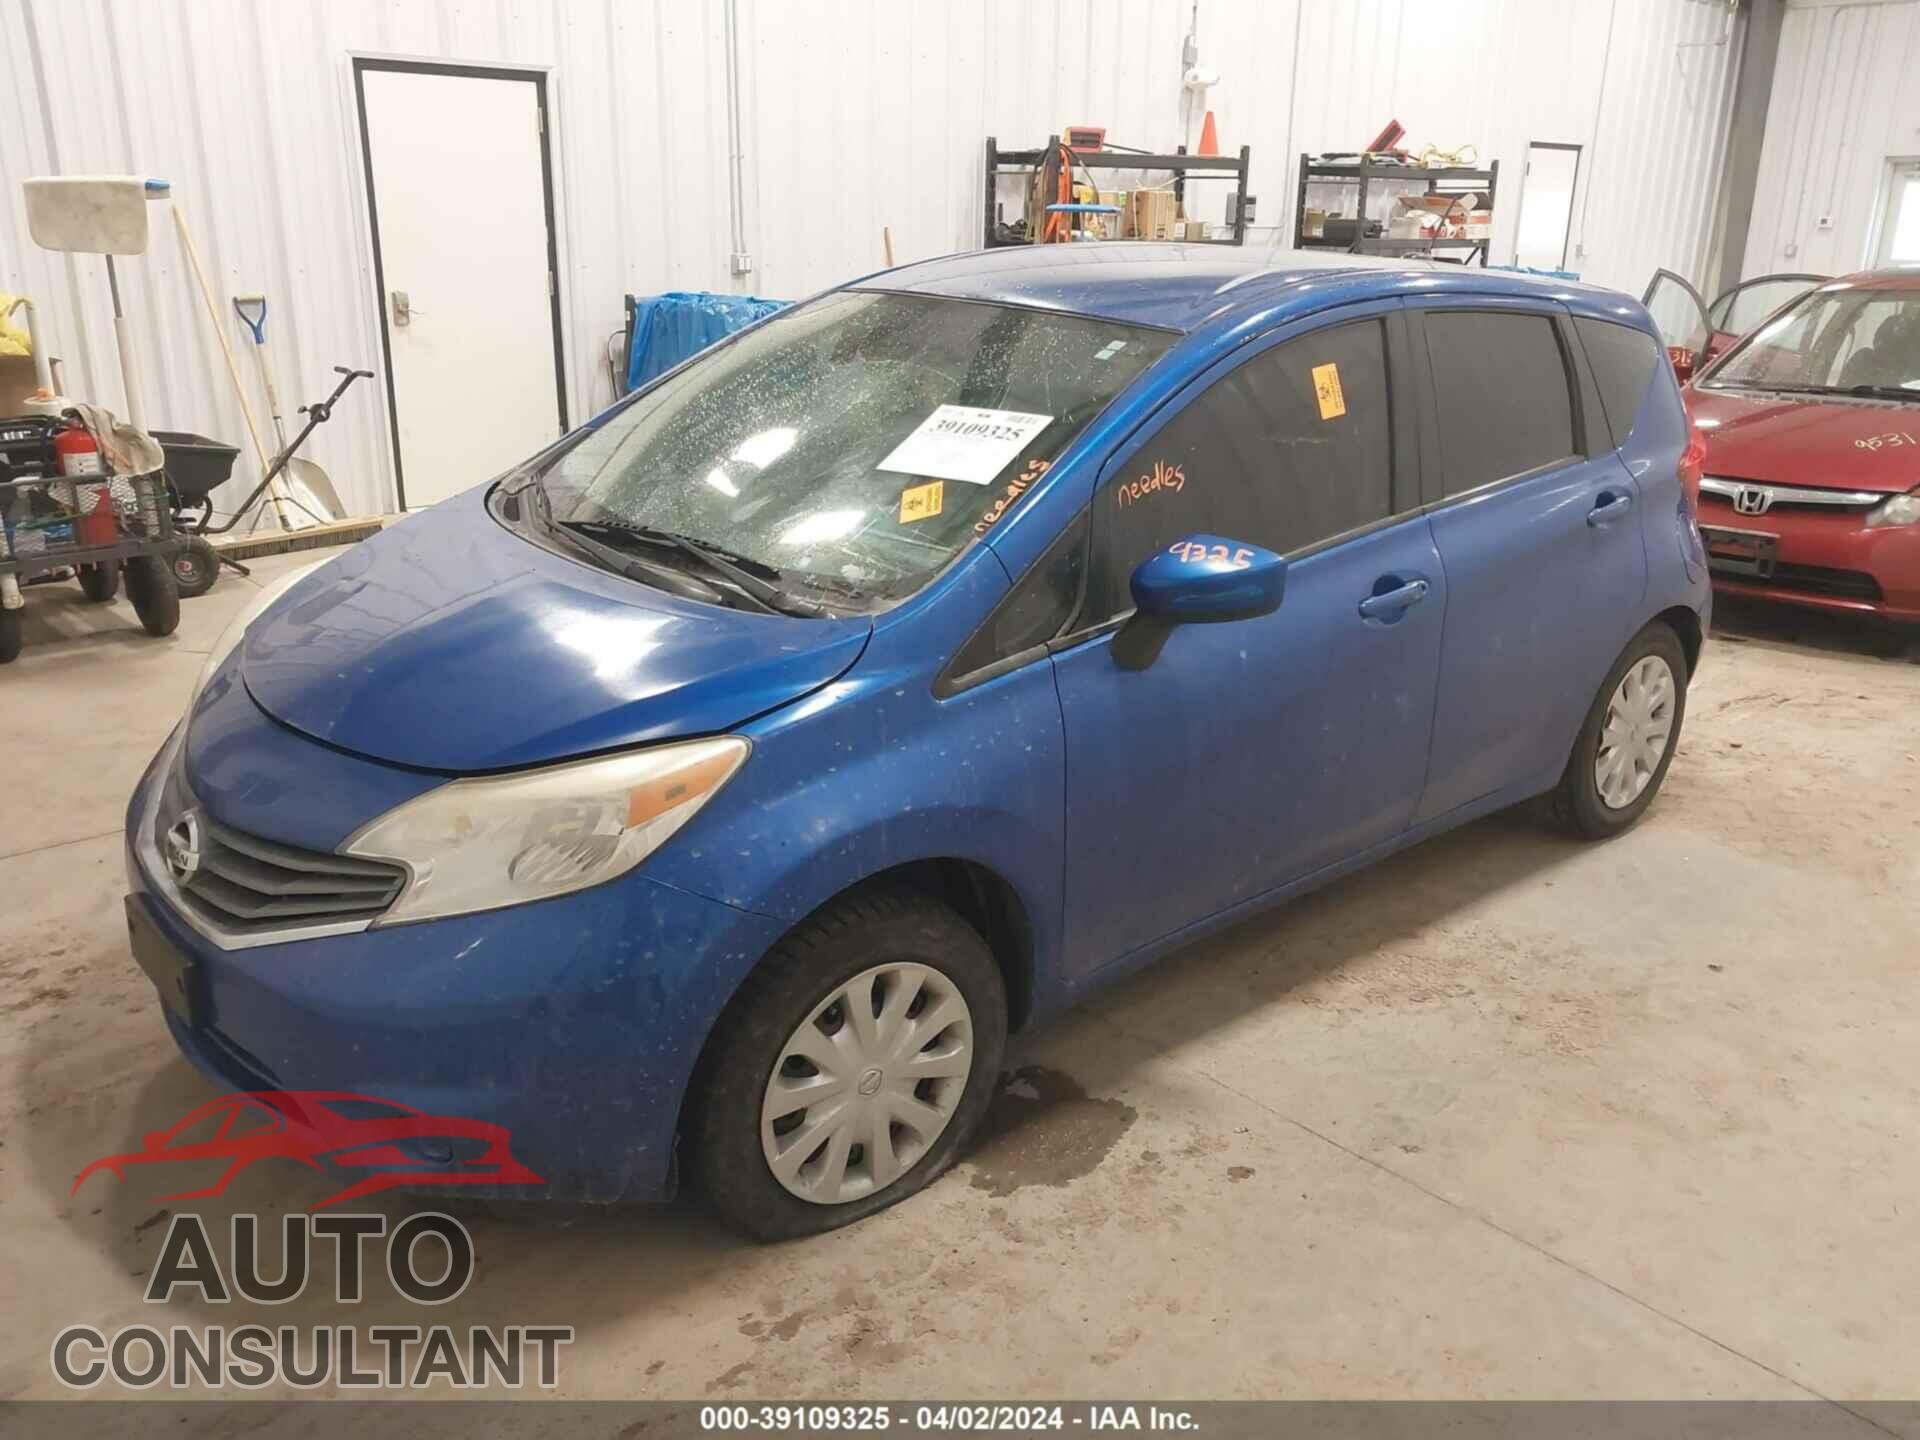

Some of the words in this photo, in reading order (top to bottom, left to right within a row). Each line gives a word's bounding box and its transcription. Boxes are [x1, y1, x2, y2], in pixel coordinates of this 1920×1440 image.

[928, 417, 1026, 441] 39109325
[1854, 431, 1917, 452] 9531
[974, 457, 1050, 533] needles
[1117, 459, 1186, 509] needles
